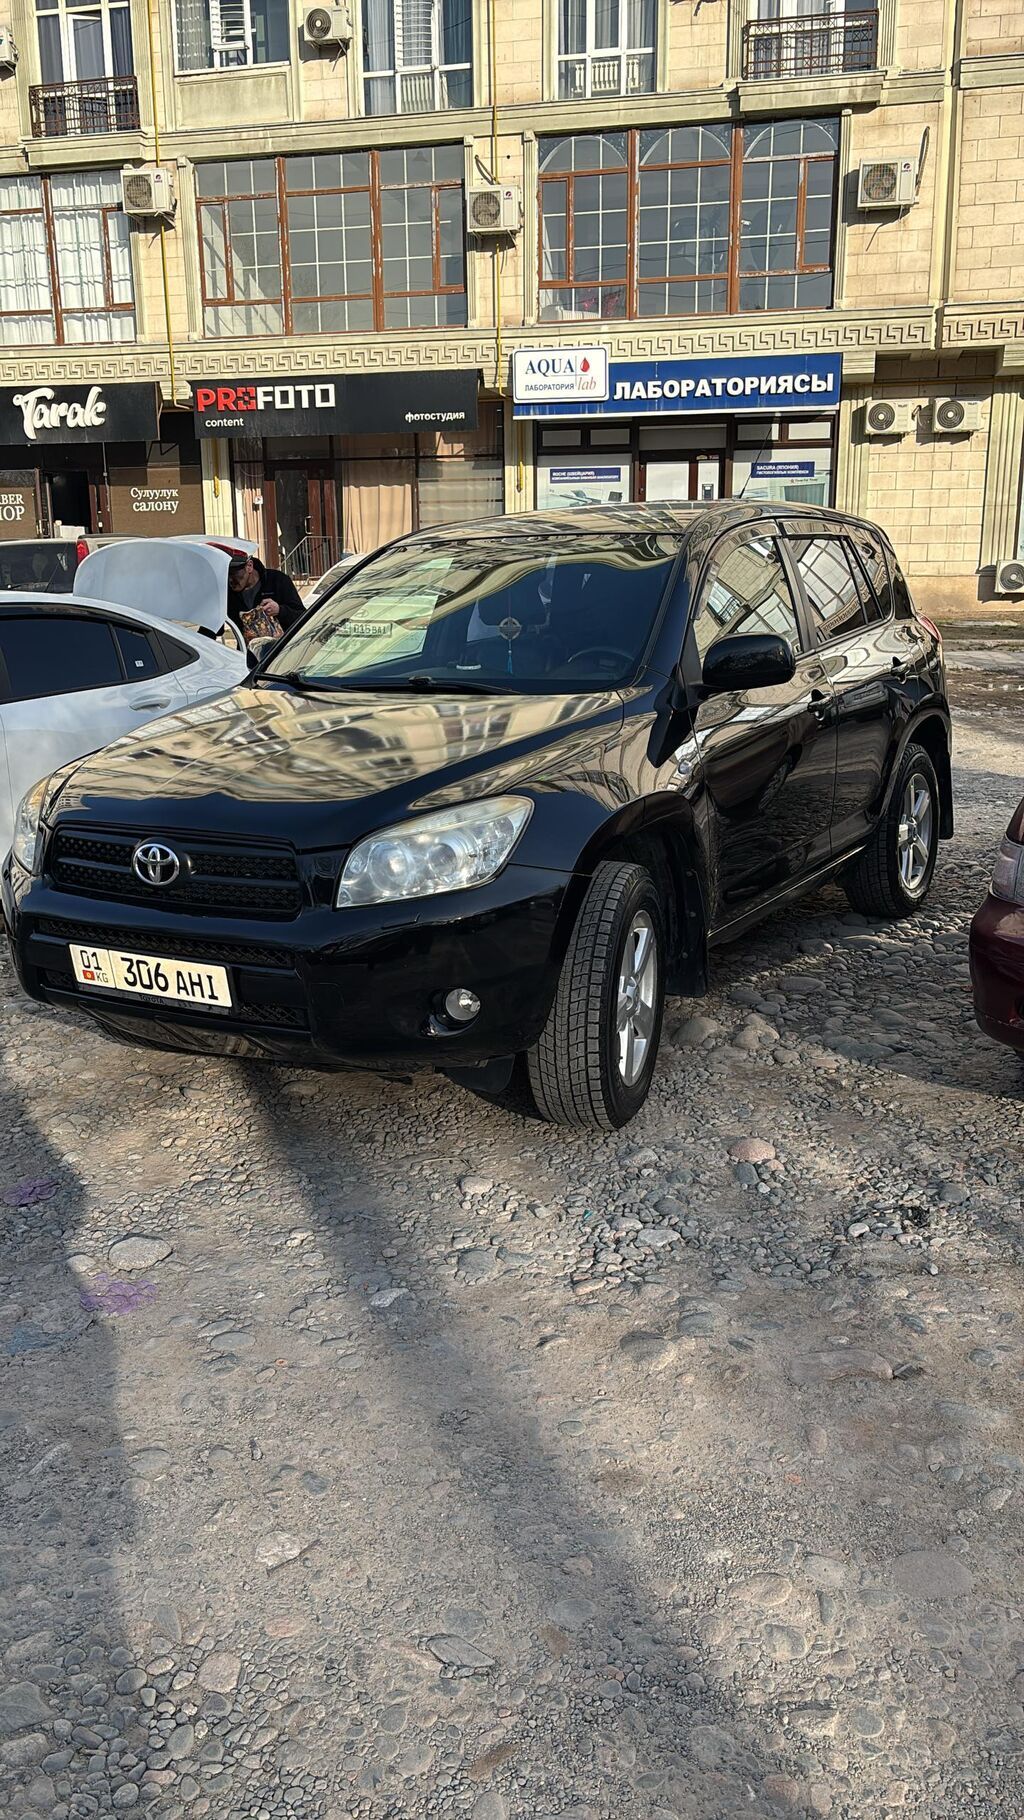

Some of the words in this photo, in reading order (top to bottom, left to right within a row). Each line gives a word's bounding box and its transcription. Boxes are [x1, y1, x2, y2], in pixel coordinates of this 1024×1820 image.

[525, 358, 575, 377] AQUA
[525, 383, 575, 392] ЛАБОРАТОРИЯ
[577, 377, 597, 391] lab
[614, 373, 834, 400] ЛАБОРАТОРИЯСЫ
[13, 386, 107, 440] Tarak
[405, 411, 466, 423] фотостудия
[205, 417, 245, 428] content
[130, 487, 179, 500] Сулуулук
[133, 501, 179, 514] салону
[80, 950, 102, 971] 01
[120, 956, 169, 992] 306
[96, 972, 109, 983] KG
